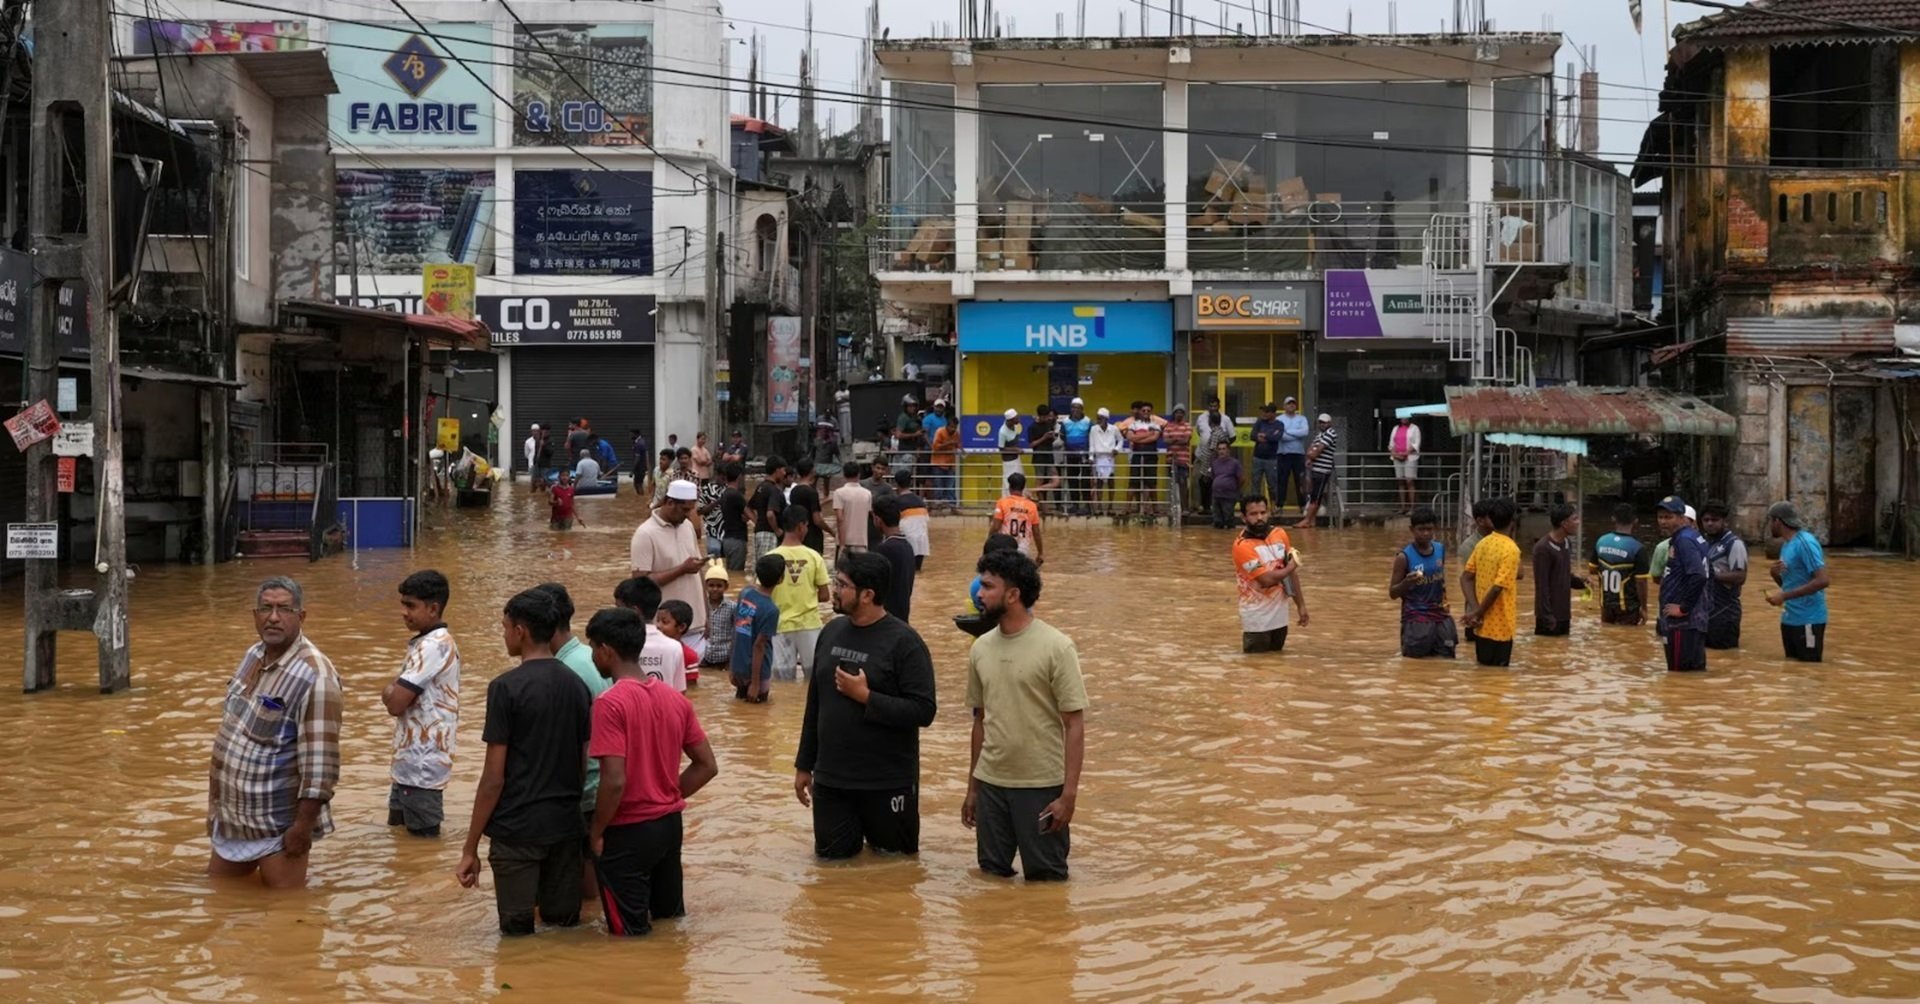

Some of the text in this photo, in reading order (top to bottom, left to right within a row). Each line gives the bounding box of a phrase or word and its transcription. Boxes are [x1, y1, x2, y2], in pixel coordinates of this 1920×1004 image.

[350, 101, 613, 134] FABRIC & CO.
[593, 205, 604, 216] &
[602, 231, 612, 241] &
[588, 258, 597, 268] &
[600, 258, 641, 269] 有限公司
[500, 298, 561, 330] CO.
[569, 308, 590, 317] MAIN
[1197, 294, 1251, 317] BOC
[567, 330, 588, 340] 0775
[1025, 324, 1088, 348] HNB
[1010, 519, 1027, 538] 04
[1602, 569, 1622, 594] 10
[890, 795, 905, 813] 07
